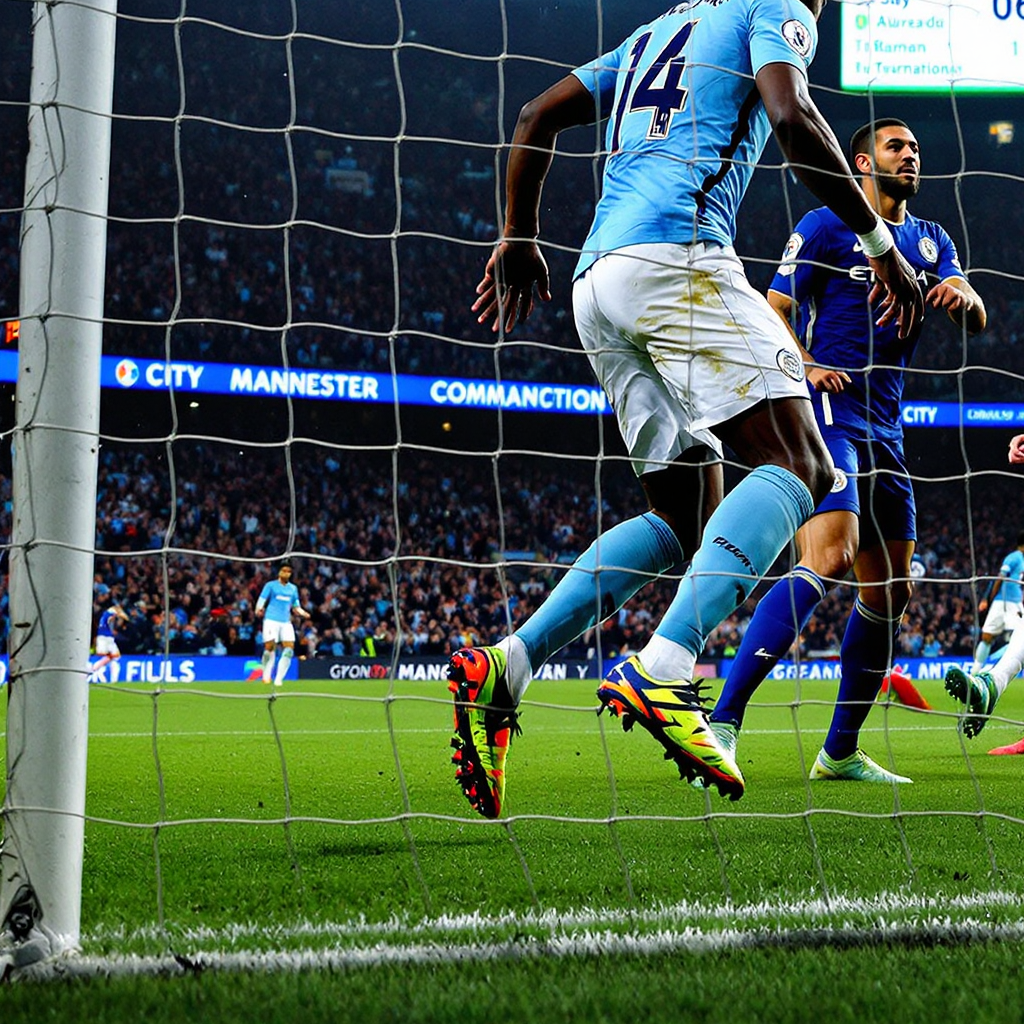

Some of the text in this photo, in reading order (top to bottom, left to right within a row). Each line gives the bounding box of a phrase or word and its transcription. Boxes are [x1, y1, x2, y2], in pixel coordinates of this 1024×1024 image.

[609, 19, 701, 153] 14
[145, 363, 606, 411] CITY MANNESTER COMMANCTION
[903, 406, 937, 424] CITY
